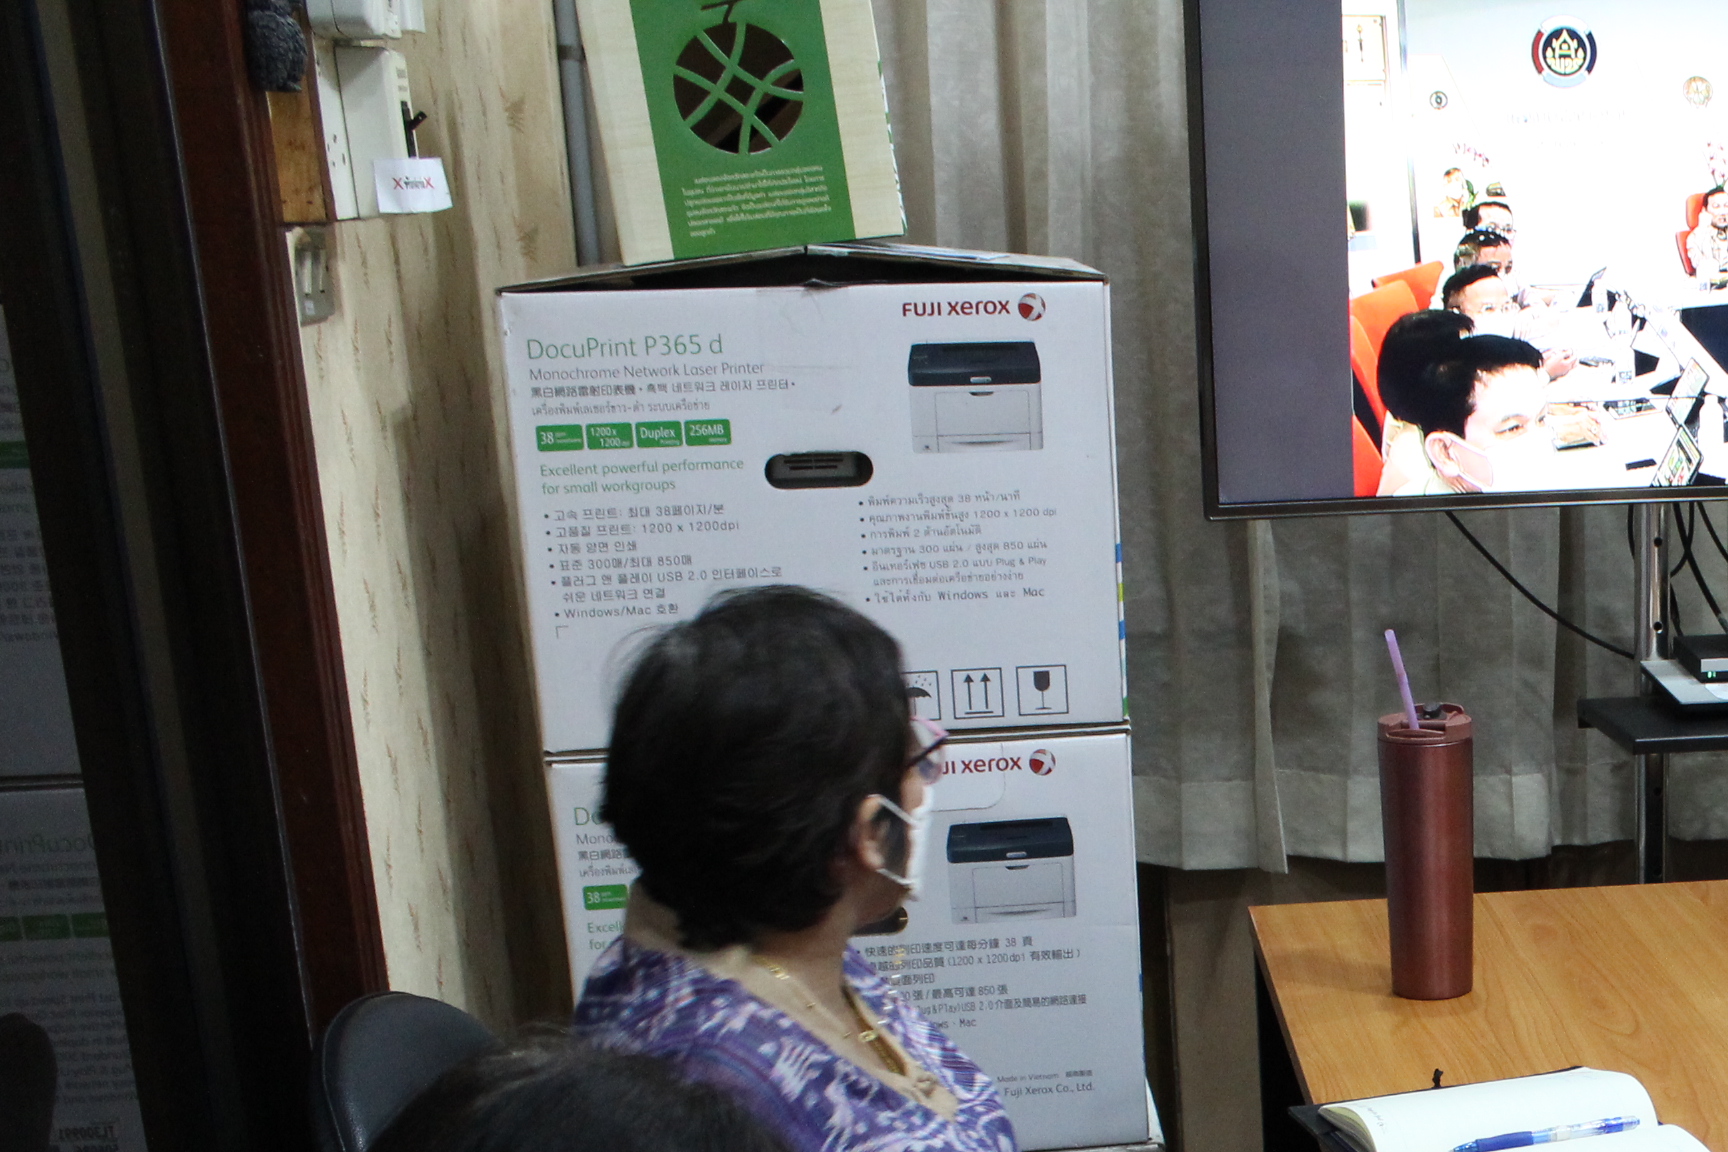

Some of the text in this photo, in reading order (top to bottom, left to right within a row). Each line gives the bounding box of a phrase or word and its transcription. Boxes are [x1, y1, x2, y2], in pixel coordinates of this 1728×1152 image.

[902, 299, 1011, 317] FUJI xerox
[526, 333, 723, 360] DocuPrint P365 d
[529, 362, 765, 381] Monochrome Network Laser Printer
[672, 380, 716, 393] 네트워크
[720, 379, 752, 391] 레이저
[640, 425, 676, 440] Duplex
[690, 423, 724, 436] 256MB
[540, 432, 554, 444] 38
[540, 459, 744, 478] Excellent powerful performance
[541, 479, 676, 495] for small workgroups
[554, 509, 578, 521] 고속
[628, 506, 651, 518] 최대
[974, 510, 1000, 519] 1200
[1013, 508, 1039, 518] 1200
[1043, 507, 1057, 518] dpi
[556, 526, 591, 538] 고품질
[642, 522, 672, 534] 1200
[689, 521, 740, 532] 1200dpi
[913, 529, 920, 538] 2
[558, 540, 637, 555] 자동 양면 인쇄
[918, 544, 940, 554] 300
[1003, 541, 1024, 551] 850
[560, 559, 583, 571] 표준
[657, 555, 693, 567] 850매
[929, 560, 949, 570] USB
[952, 559, 969, 569] 2.0
[972, 557, 993, 568] แบบ
[995, 557, 1016, 568] Plug
[1018, 557, 1025, 566] &
[1028, 556, 1047, 567] Play
[561, 566, 783, 588] 플러그 앤 플레이 USB 2.0 인터페이스로
[562, 588, 666, 604] 쉬운 네트워크 연결
[937, 590, 988, 602] Windows
[995, 588, 1016, 599] และ
[1023, 586, 1045, 598] Mac
[564, 602, 679, 620] Windows/Mac 호환
[961, 756, 1022, 774] xerox
[586, 892, 600, 904] 38
[589, 939, 607, 950] for
[1005, 937, 1017, 948] 38
[978, 985, 996, 996] 850
[997, 1074, 1017, 1083] Made
[1004, 1087, 1022, 1099] Fuji
[1025, 1085, 1054, 1095] Xerox
[1076, 1082, 1095, 1092] Ltd.
